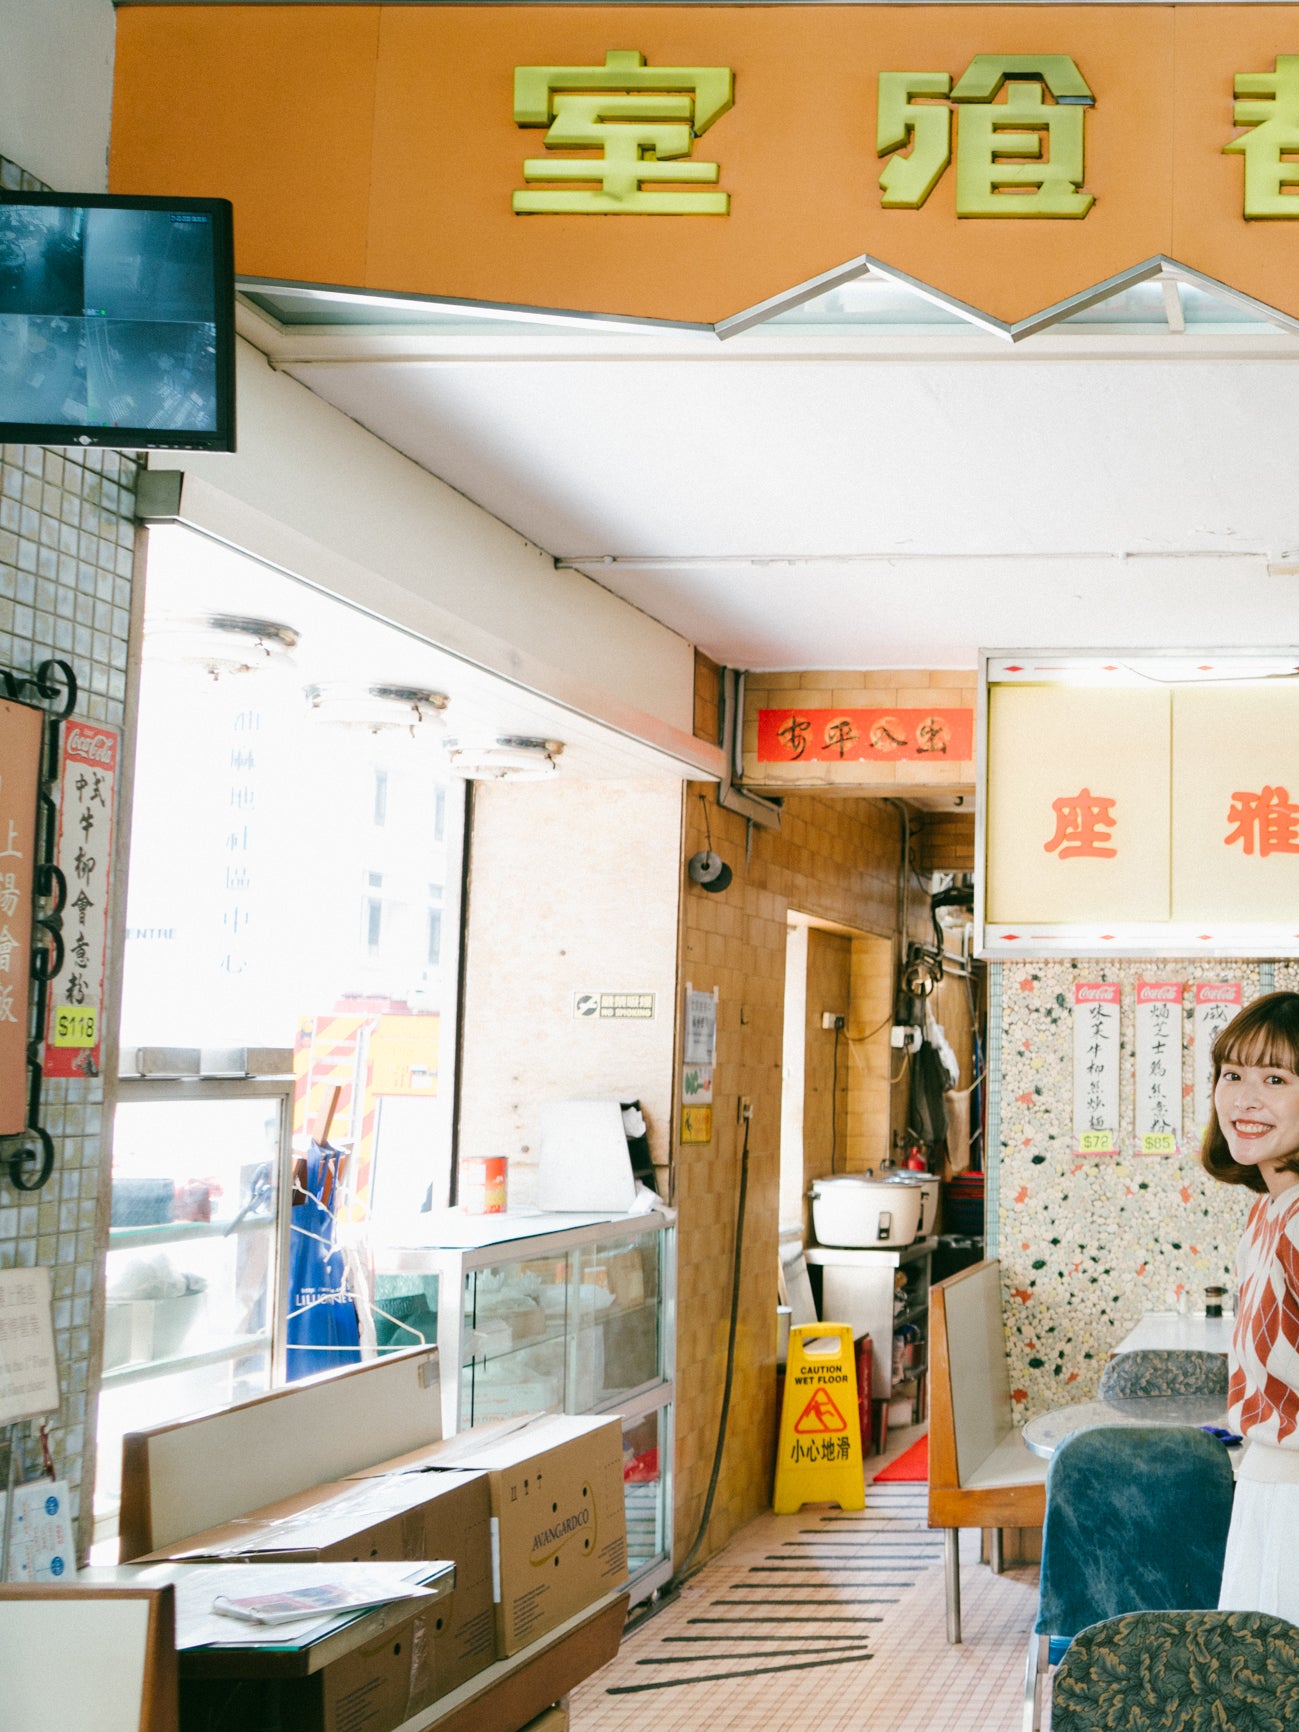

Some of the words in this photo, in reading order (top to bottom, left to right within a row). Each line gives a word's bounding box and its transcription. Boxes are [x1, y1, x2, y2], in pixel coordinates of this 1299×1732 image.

[800, 1365, 842, 1375] CAUTION
[795, 1376, 814, 1385] WET
[818, 1374, 848, 1384] FLOOR
[790, 1437, 851, 1463] 小心地滑
[531, 1508, 589, 1552] AVANGARDCO
